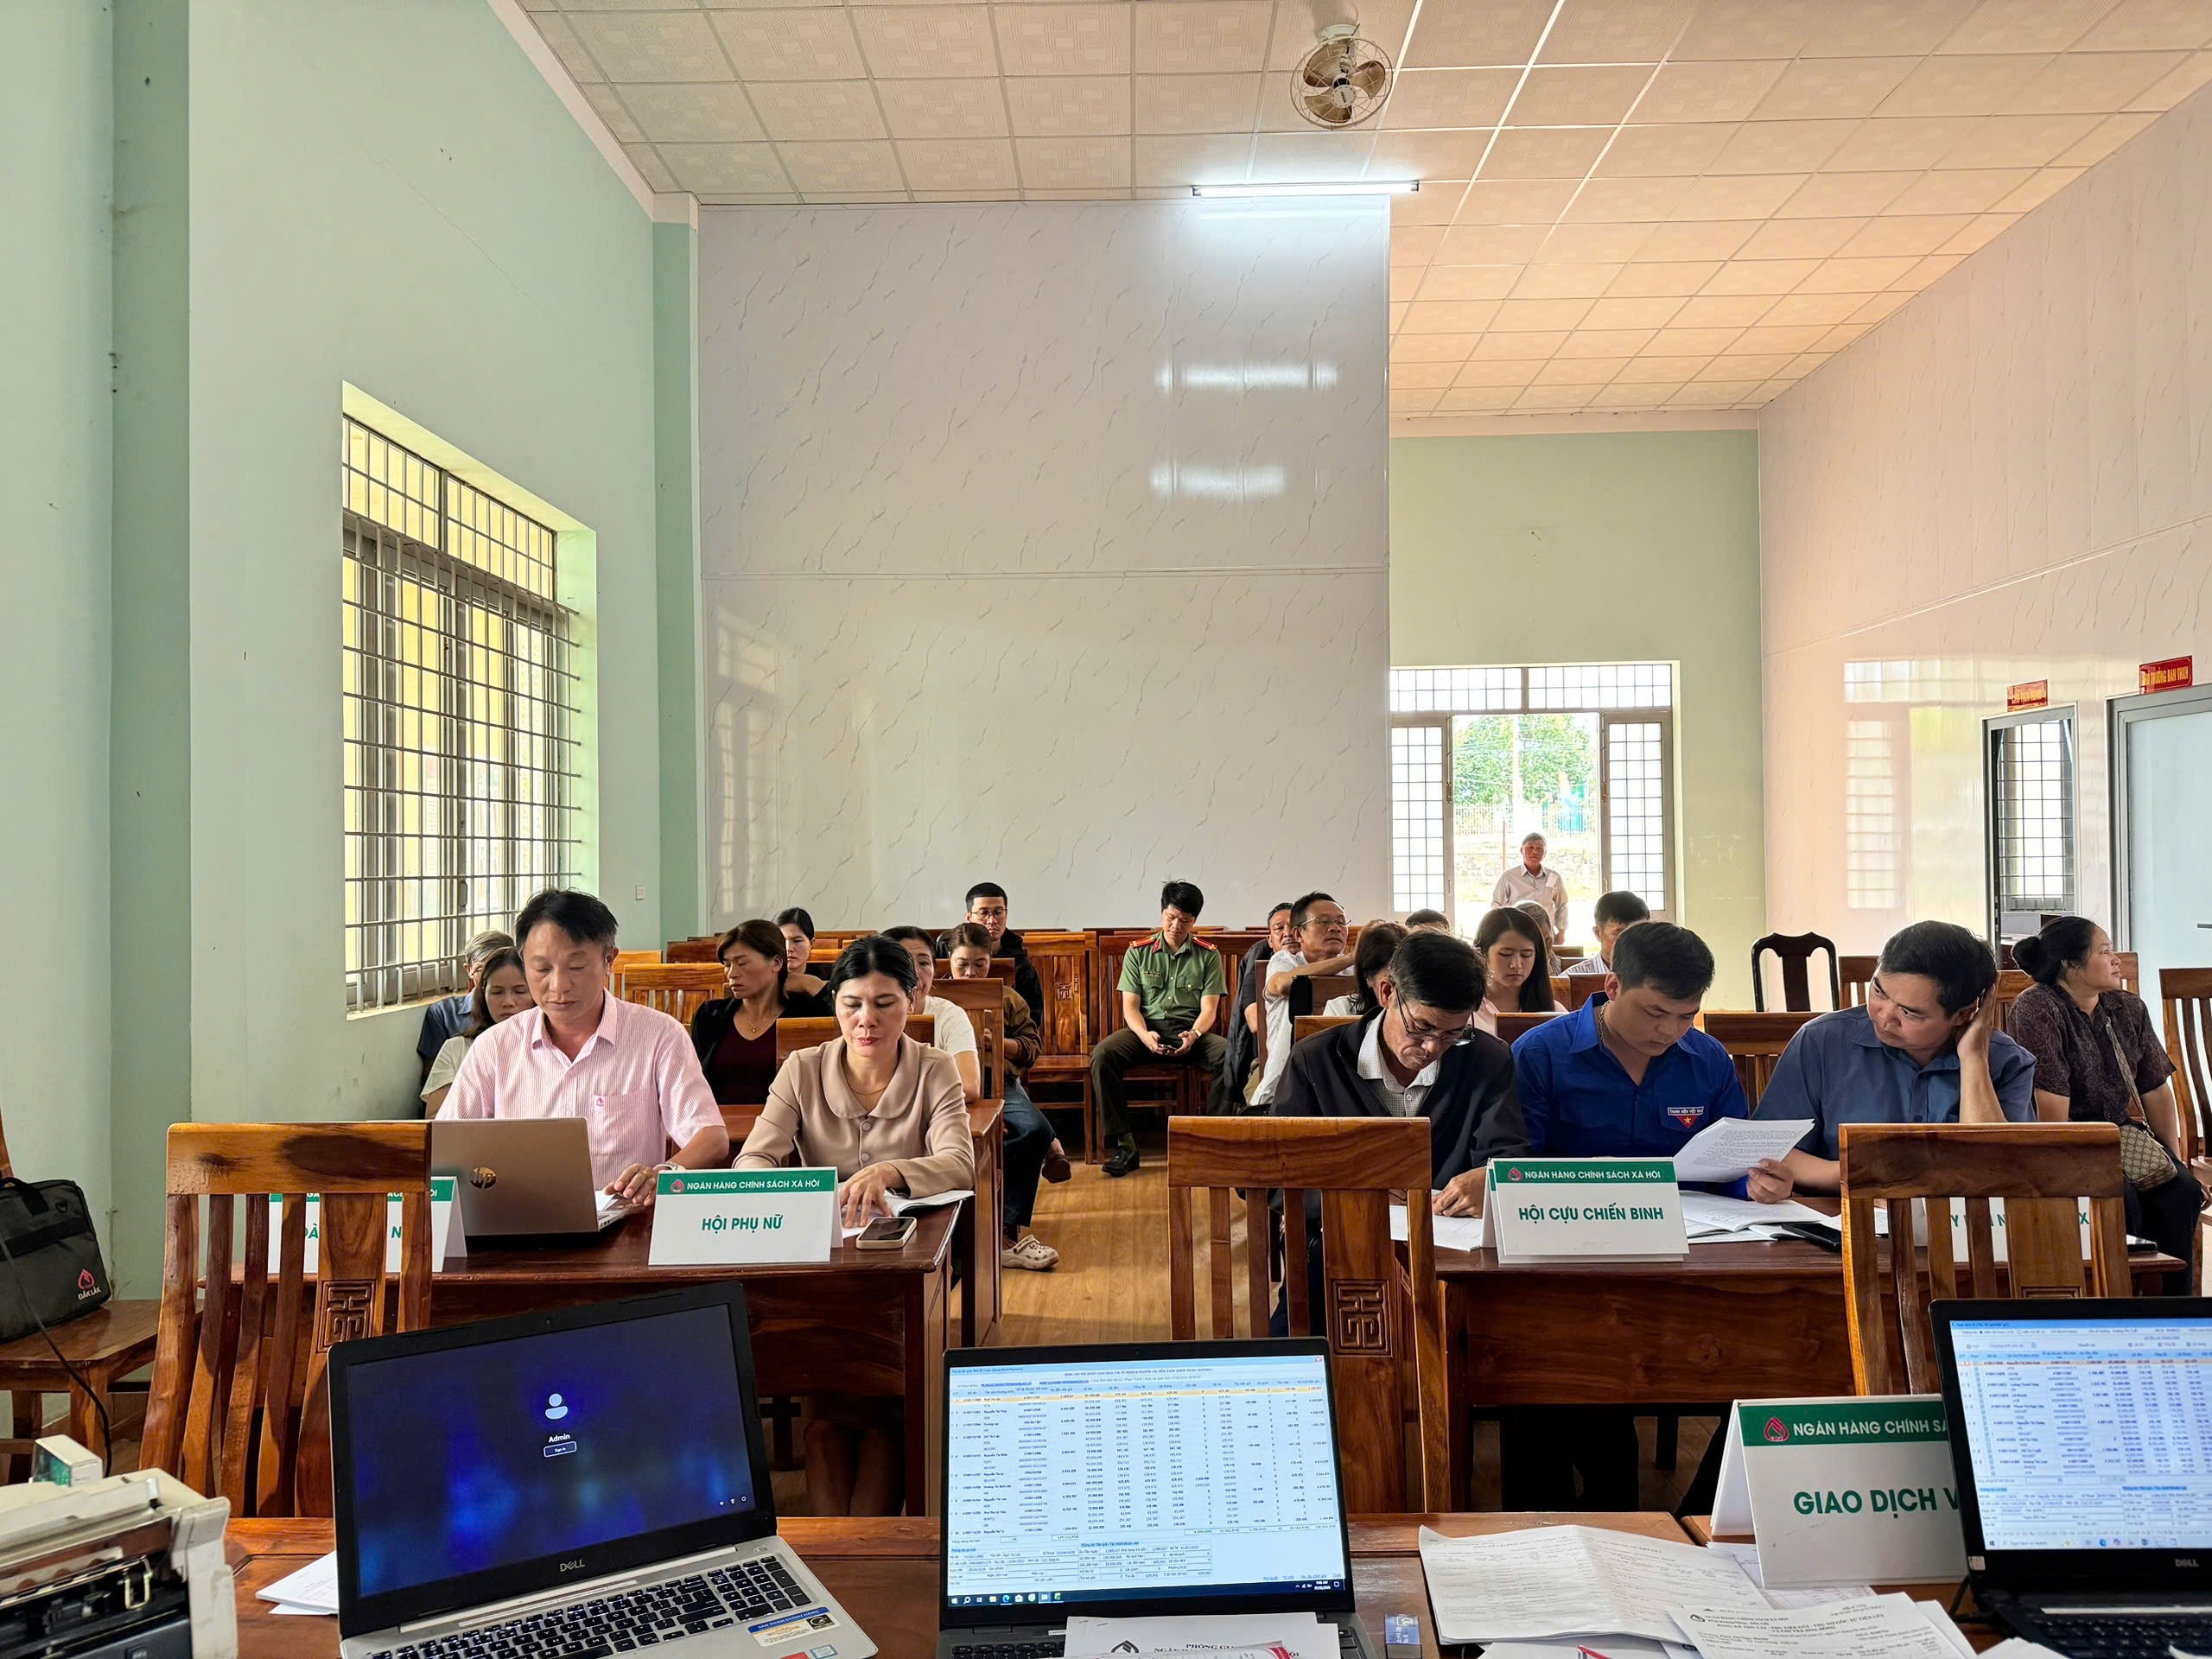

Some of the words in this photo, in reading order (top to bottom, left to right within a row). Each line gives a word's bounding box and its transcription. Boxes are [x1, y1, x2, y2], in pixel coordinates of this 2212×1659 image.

[1525, 1169, 1549, 1179] NGÂN
[1552, 1169, 1576, 1179] HÀNG
[1578, 1169, 1605, 1179] CHÍNH
[1606, 1169, 1630, 1179] SÁCH
[687, 1181, 711, 1190] NGÂN
[713, 1180, 737, 1189] HÀNG
[739, 1179, 766, 1189] CHÍNH
[766, 1179, 790, 1188] SÁCH
[804, 1179, 820, 1189] HỘI
[1519, 1204, 1545, 1224] HỘI
[1549, 1205, 1579, 1224] CỰU
[1583, 1202, 1626, 1220] CHIẾN
[1630, 1206, 1664, 1220] BINH
[702, 1214, 728, 1234] HỘI
[731, 1217, 760, 1233] PHỤ
[763, 1213, 784, 1230] NỮ
[1793, 1421, 1835, 1436] NGÂN
[1839, 1419, 1880, 1435] HÀNG
[1884, 1419, 1929, 1434] CHÍNH
[549, 1433, 570, 1443] Admin
[1793, 1490, 1863, 1515] GIAO
[1870, 1488, 1937, 1518] DỊCH
[1943, 1487, 1960, 1510] V
[560, 1559, 585, 1572] DELL
[2175, 1558, 2199, 1567] DELL
